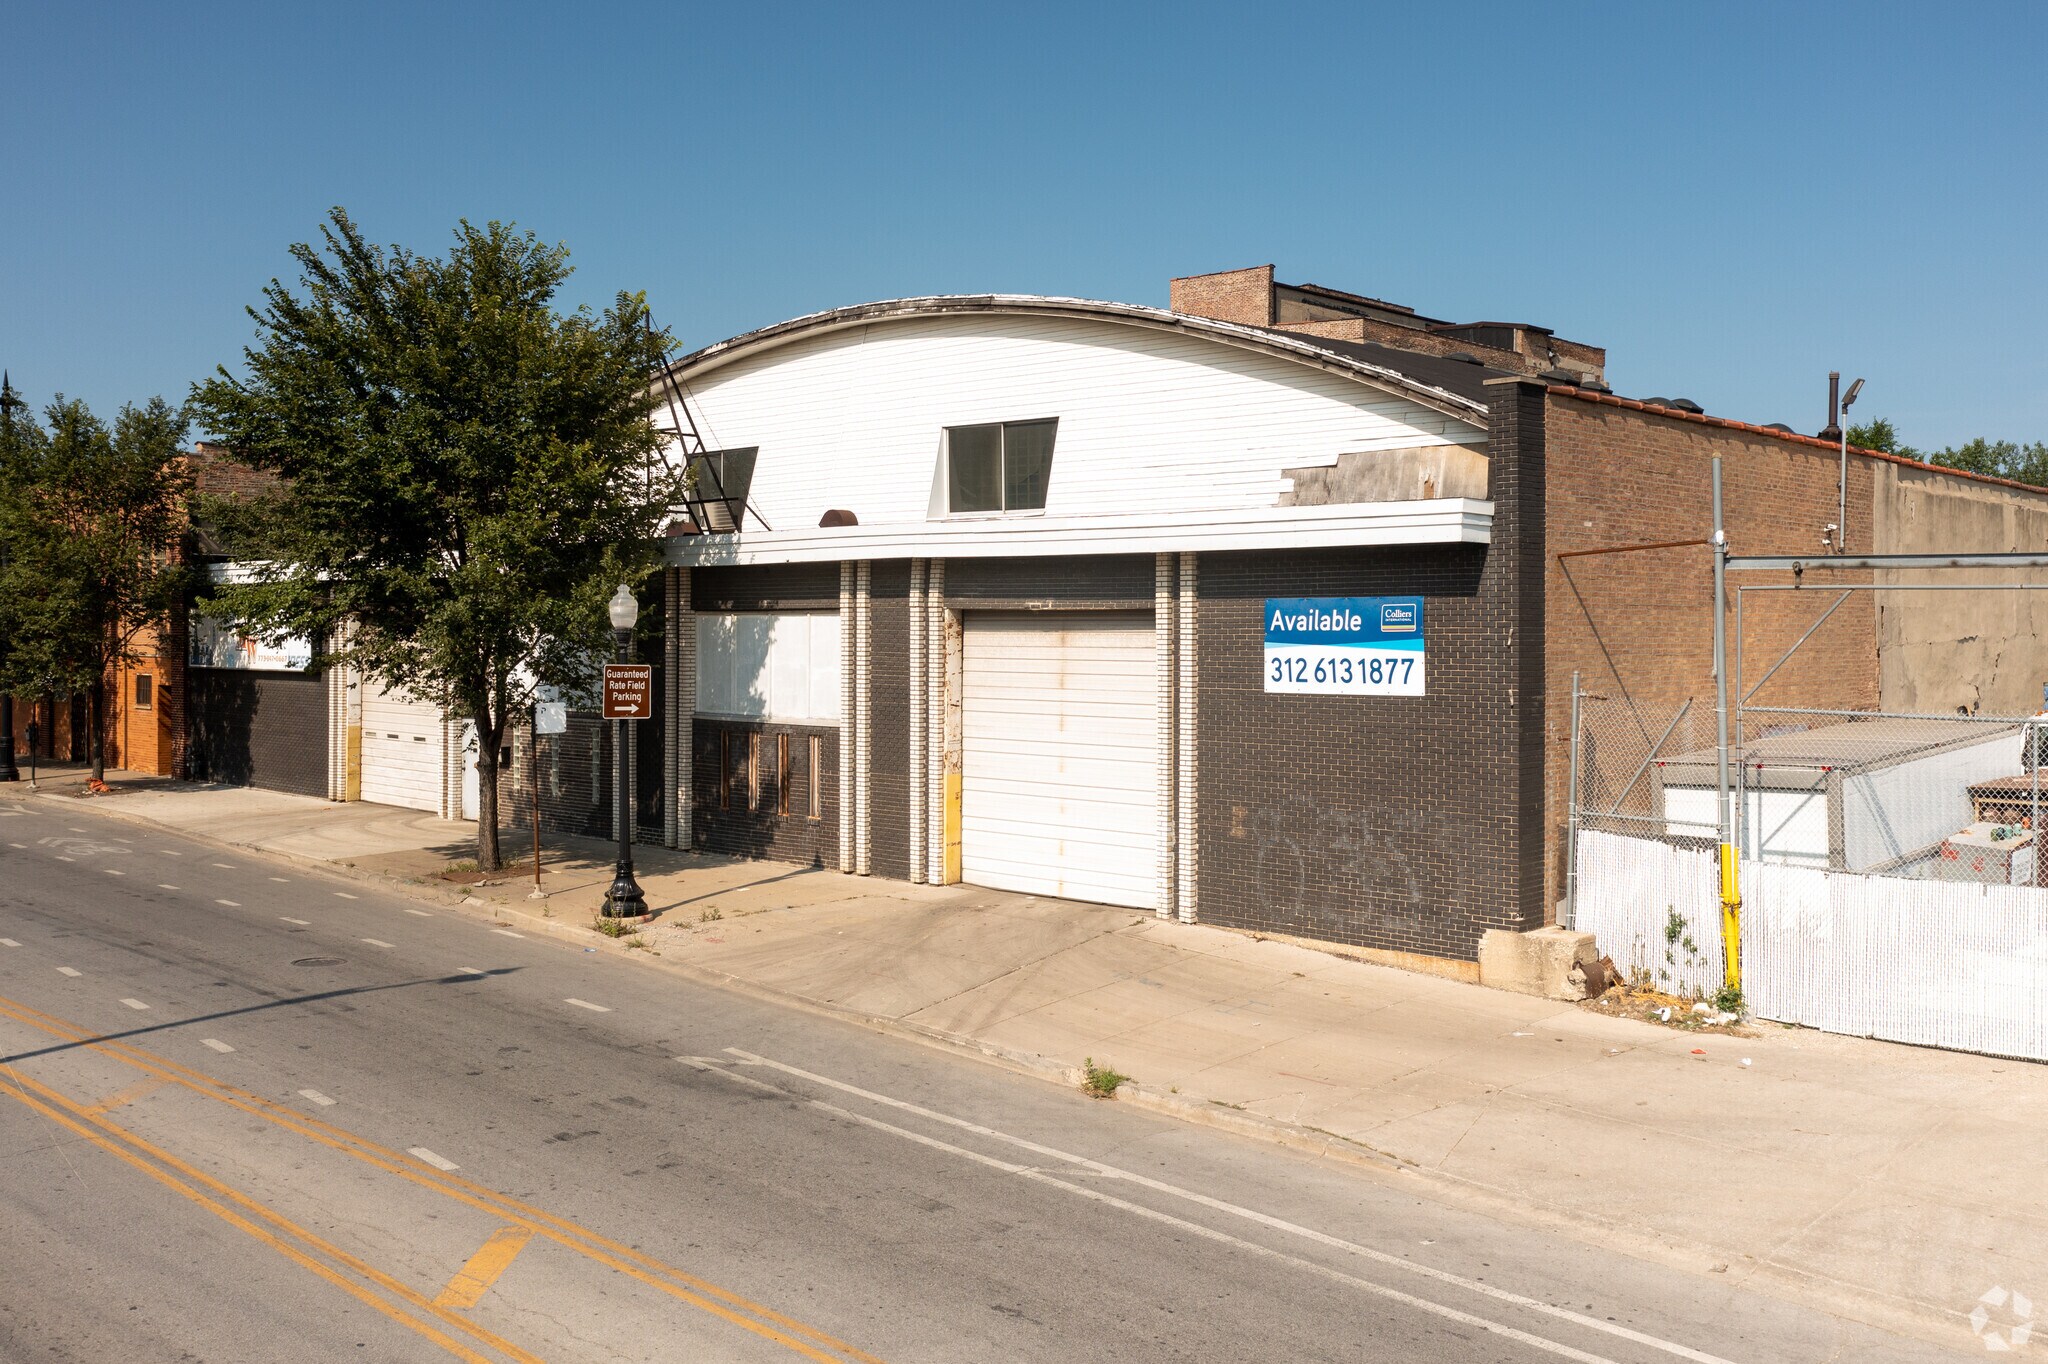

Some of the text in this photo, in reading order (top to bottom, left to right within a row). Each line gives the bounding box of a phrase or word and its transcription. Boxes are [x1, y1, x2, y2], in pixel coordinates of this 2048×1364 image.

[1385, 609, 1412, 618] Colliers
[1270, 609, 1362, 632] Available
[606, 669, 649, 679] Guaranteed
[1271, 657, 1415, 685] 312 613 1877
[609, 681, 646, 690] Rate Field
[612, 691, 642, 704] Parking
